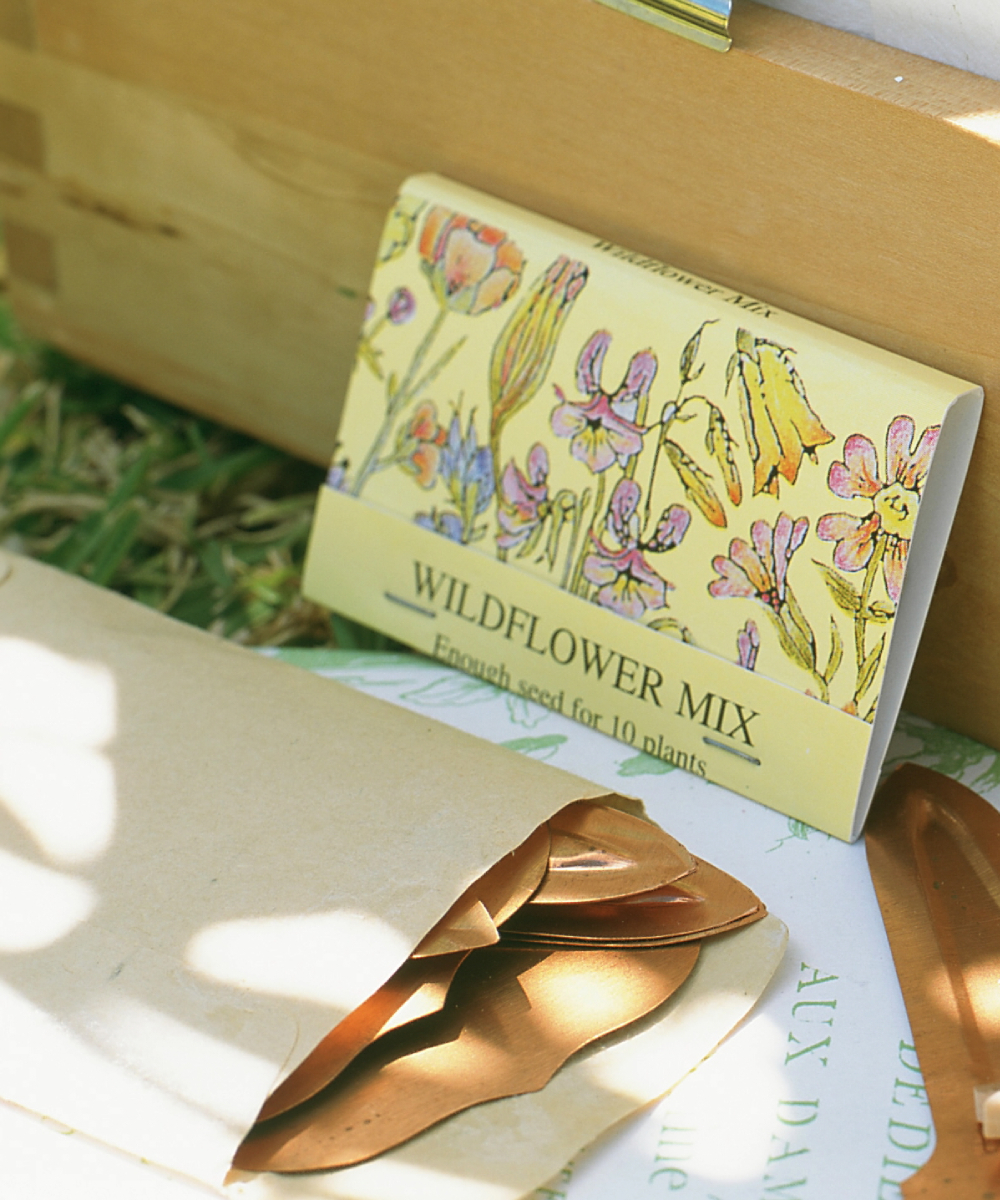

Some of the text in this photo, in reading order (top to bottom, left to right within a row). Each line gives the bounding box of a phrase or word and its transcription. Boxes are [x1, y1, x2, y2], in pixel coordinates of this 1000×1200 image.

[413, 561, 760, 747] WILDFLOWER MIX
[432, 632, 708, 778] Enough seed for 10 plants
[784, 961, 839, 1067] AUX
